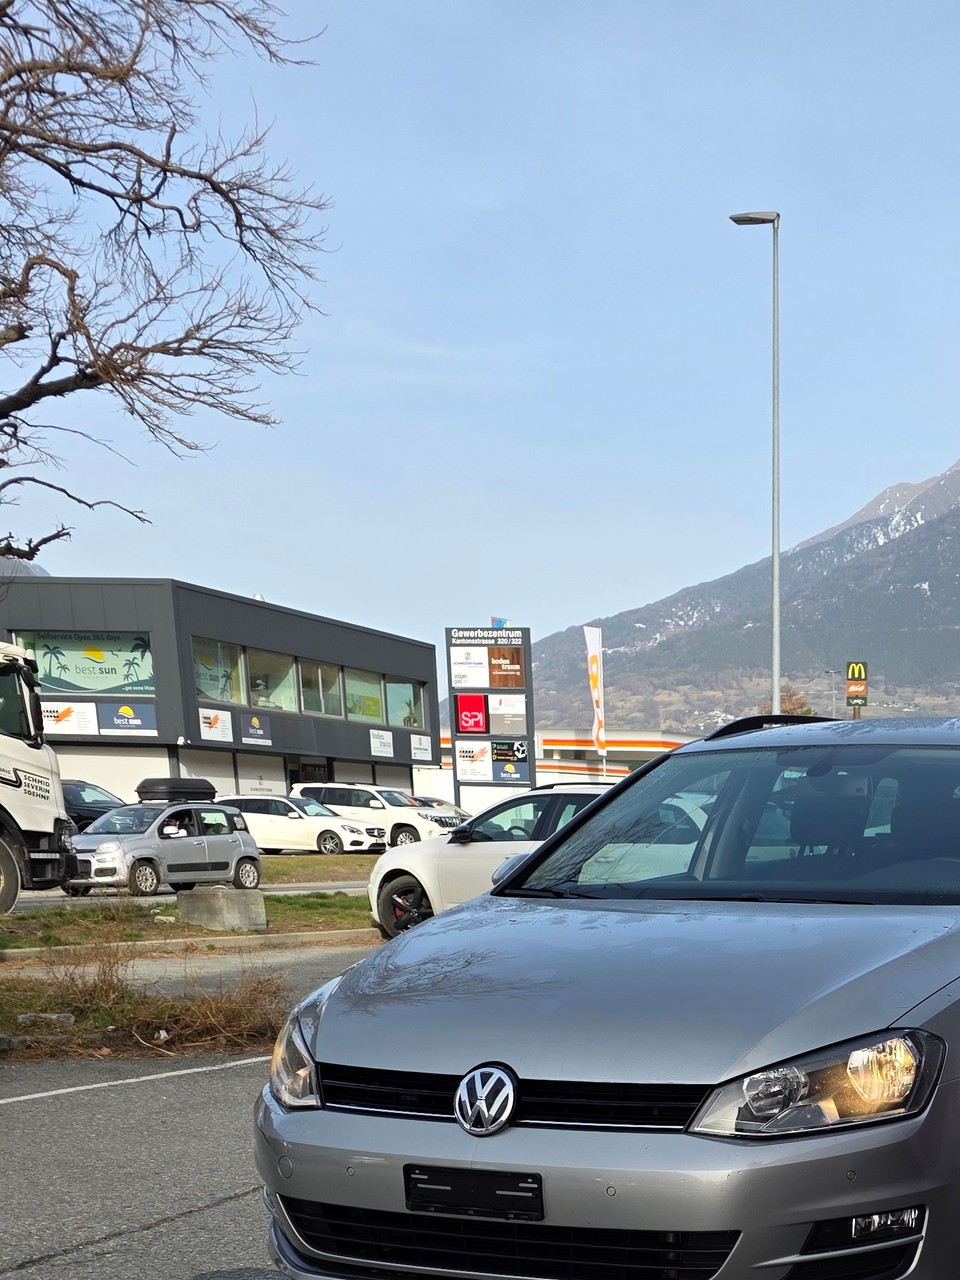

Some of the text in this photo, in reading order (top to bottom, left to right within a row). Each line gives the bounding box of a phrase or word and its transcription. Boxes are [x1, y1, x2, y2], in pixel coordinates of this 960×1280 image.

[74, 633, 91, 642] Open
[451, 629, 522, 638] Gewerbezentrum
[491, 657, 510, 665] boden
[75, 664, 118, 675] best sun
[114, 717, 128, 725] best
[461, 711, 483, 727] SPI
[24, 774, 50, 787] SCHMID
[24, 781, 50, 794] SEVERIN
